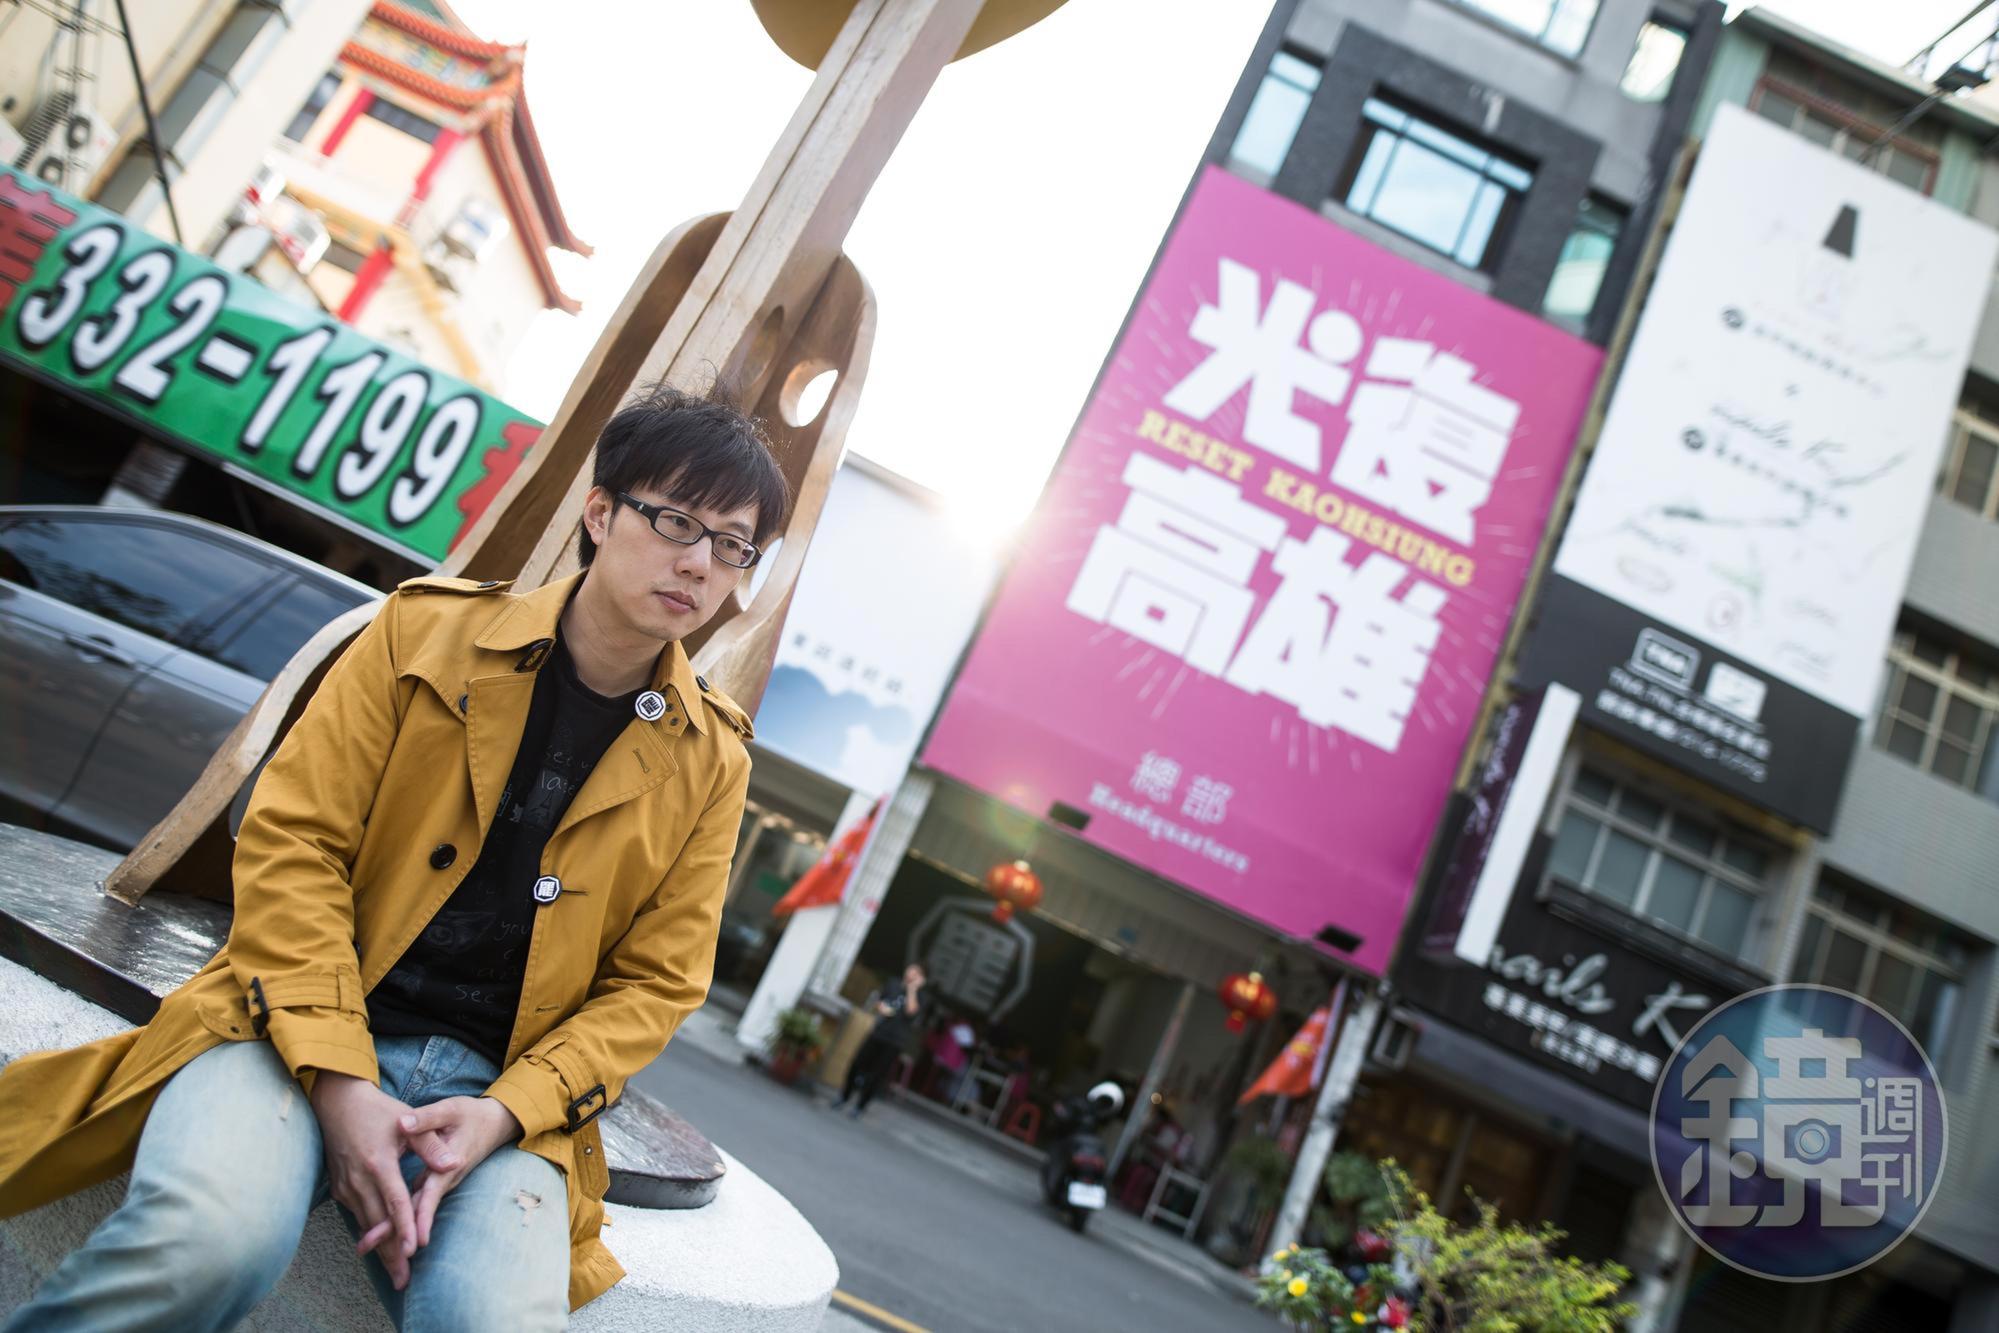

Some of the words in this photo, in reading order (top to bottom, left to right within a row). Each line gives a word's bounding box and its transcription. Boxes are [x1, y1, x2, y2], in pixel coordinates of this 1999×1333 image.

[18, 221, 484, 530] 332-1199
[1162, 256, 1522, 548] 光復
[1065, 451, 1449, 755] 高雄
[1137, 408, 1256, 483] RESET
[1263, 468, 1476, 587] KAOHSIUNG
[1089, 781, 1249, 873] Headquarters
[1632, 980, 1712, 1058] K
